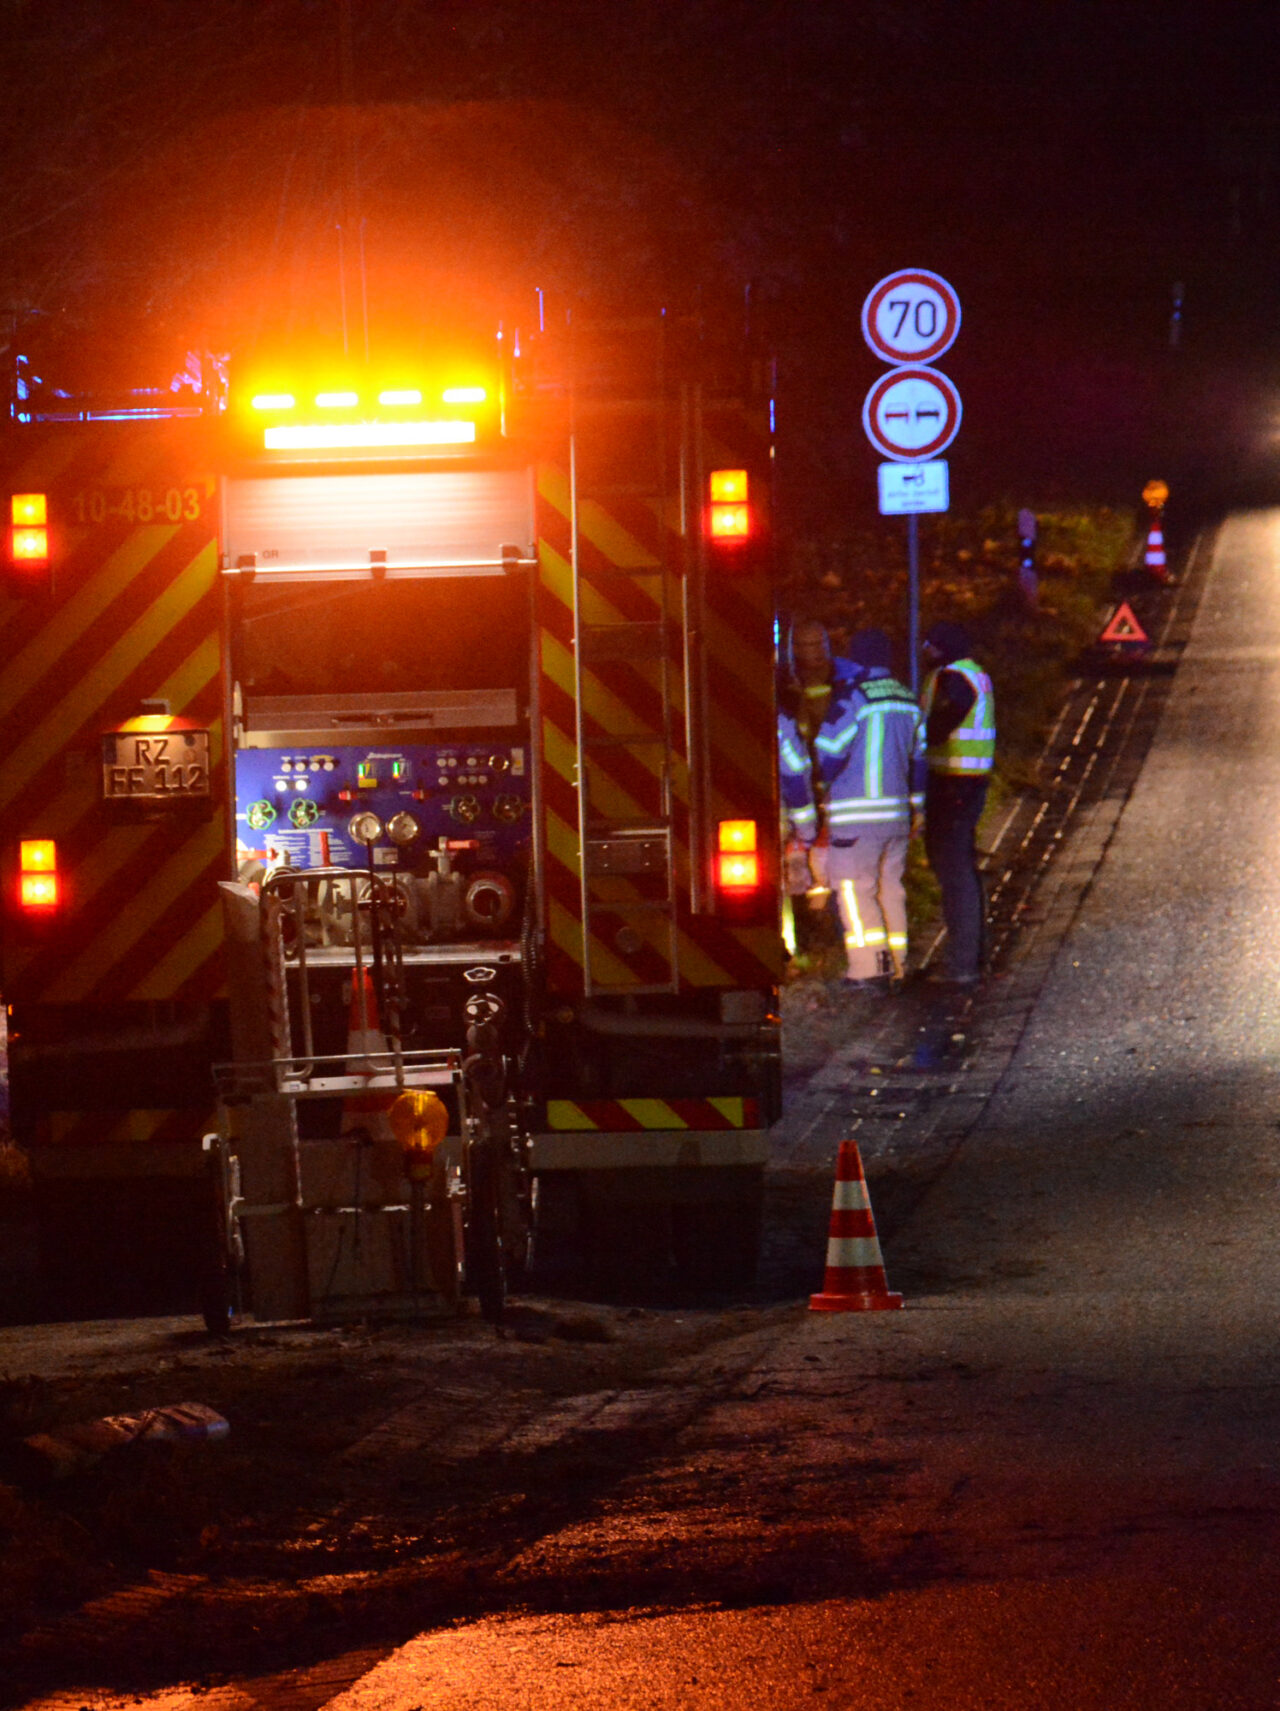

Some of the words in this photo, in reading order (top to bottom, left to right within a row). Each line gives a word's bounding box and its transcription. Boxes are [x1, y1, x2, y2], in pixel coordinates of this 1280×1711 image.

[888, 299, 937, 339] 70
[73, 488, 201, 522] 10-48-03
[134, 738, 171, 766] RZ
[110, 765, 145, 794] FF
[154, 764, 204, 792] 112
